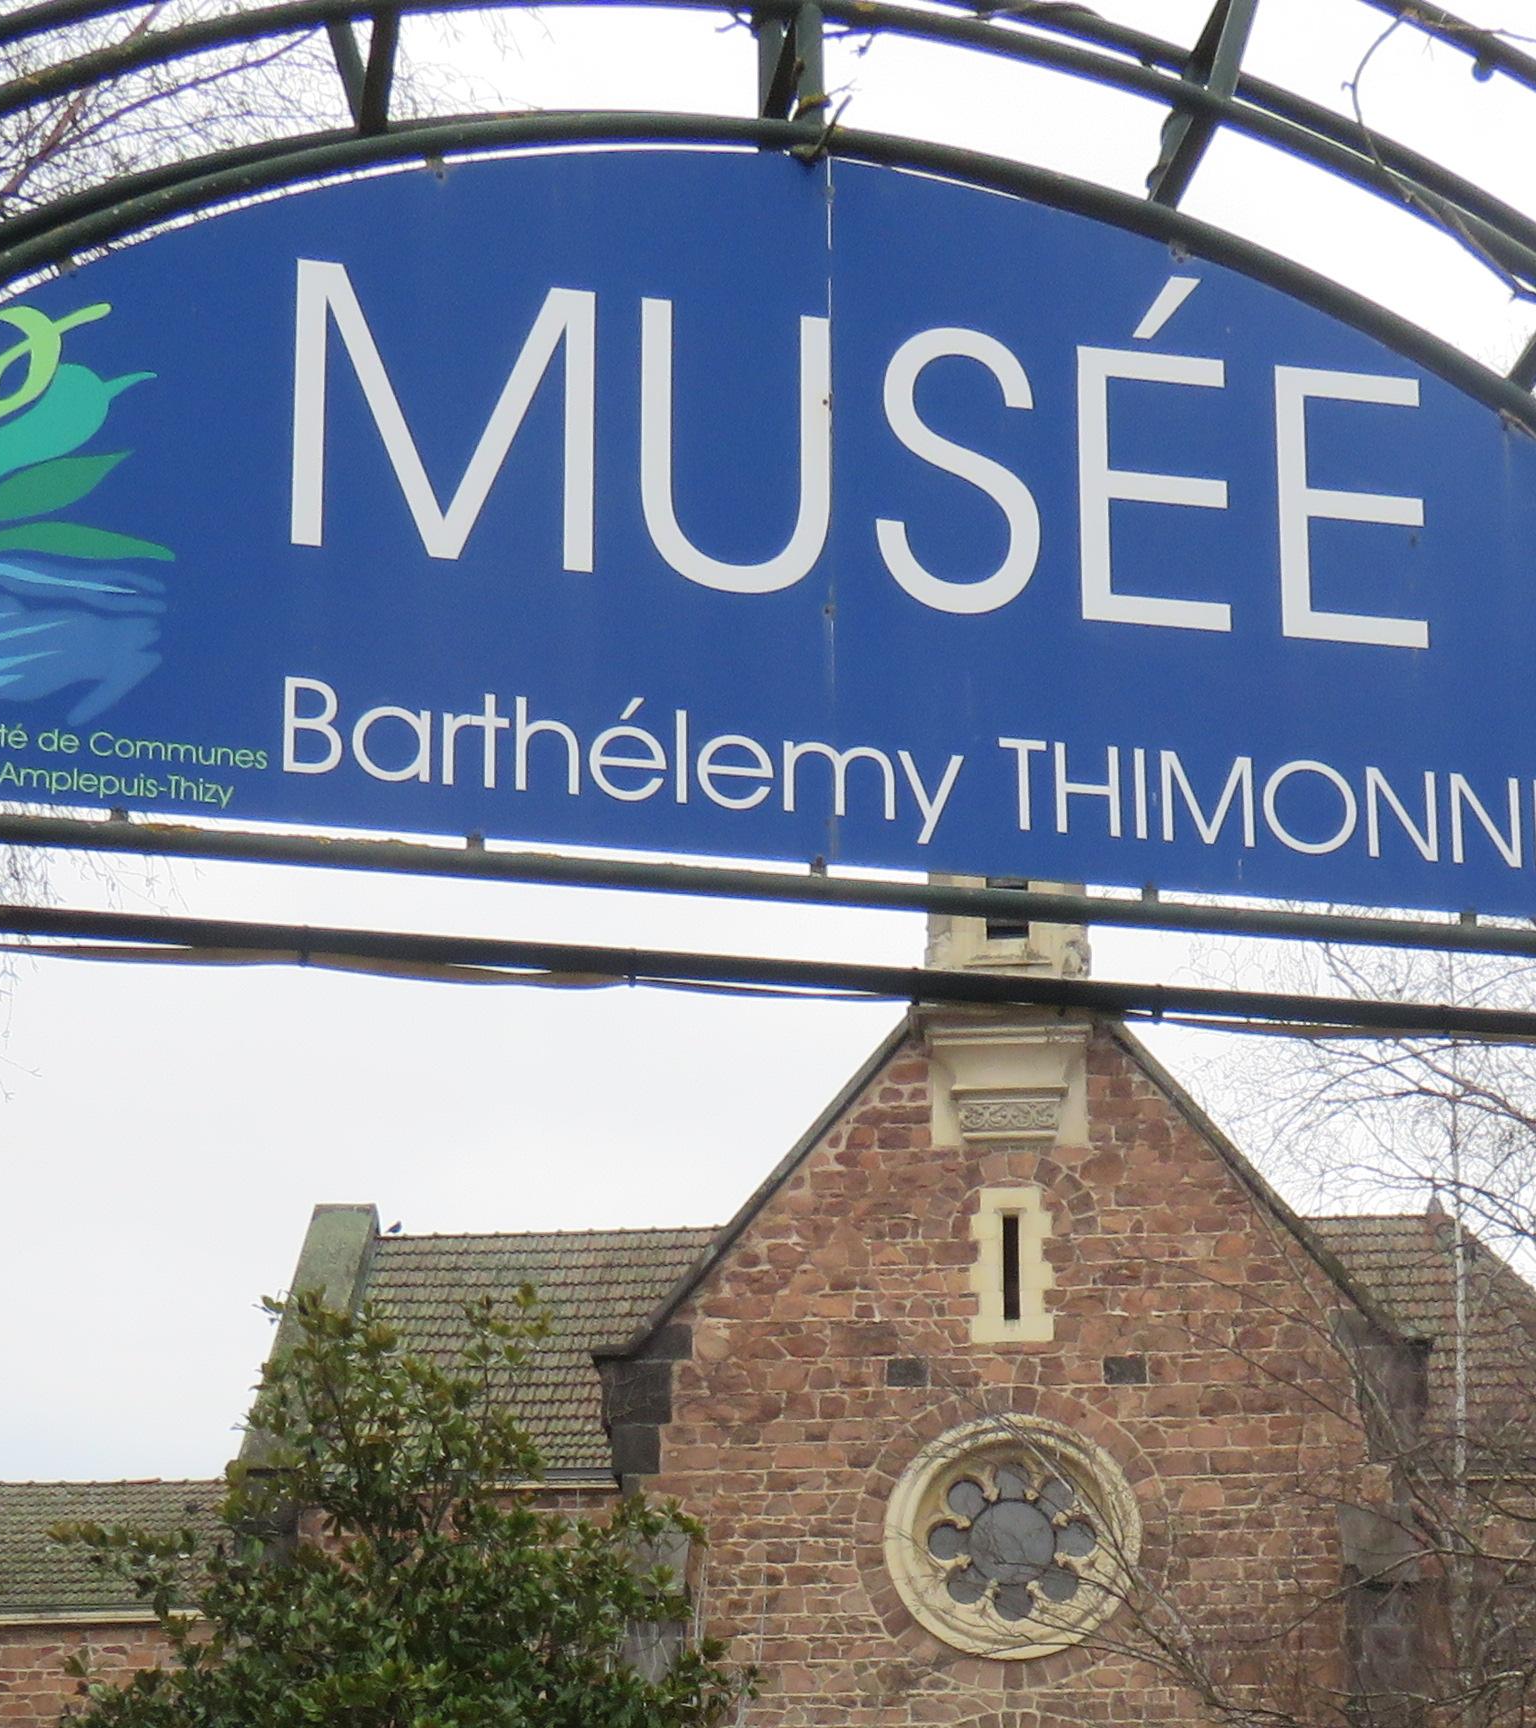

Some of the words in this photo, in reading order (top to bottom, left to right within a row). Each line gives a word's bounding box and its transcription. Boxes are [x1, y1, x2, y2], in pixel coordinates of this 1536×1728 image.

[289, 257, 1431, 650] MUSÉE
[37, 728, 81, 755] de
[89, 731, 269, 770] Communes
[281, 675, 965, 846] Barthélemy
